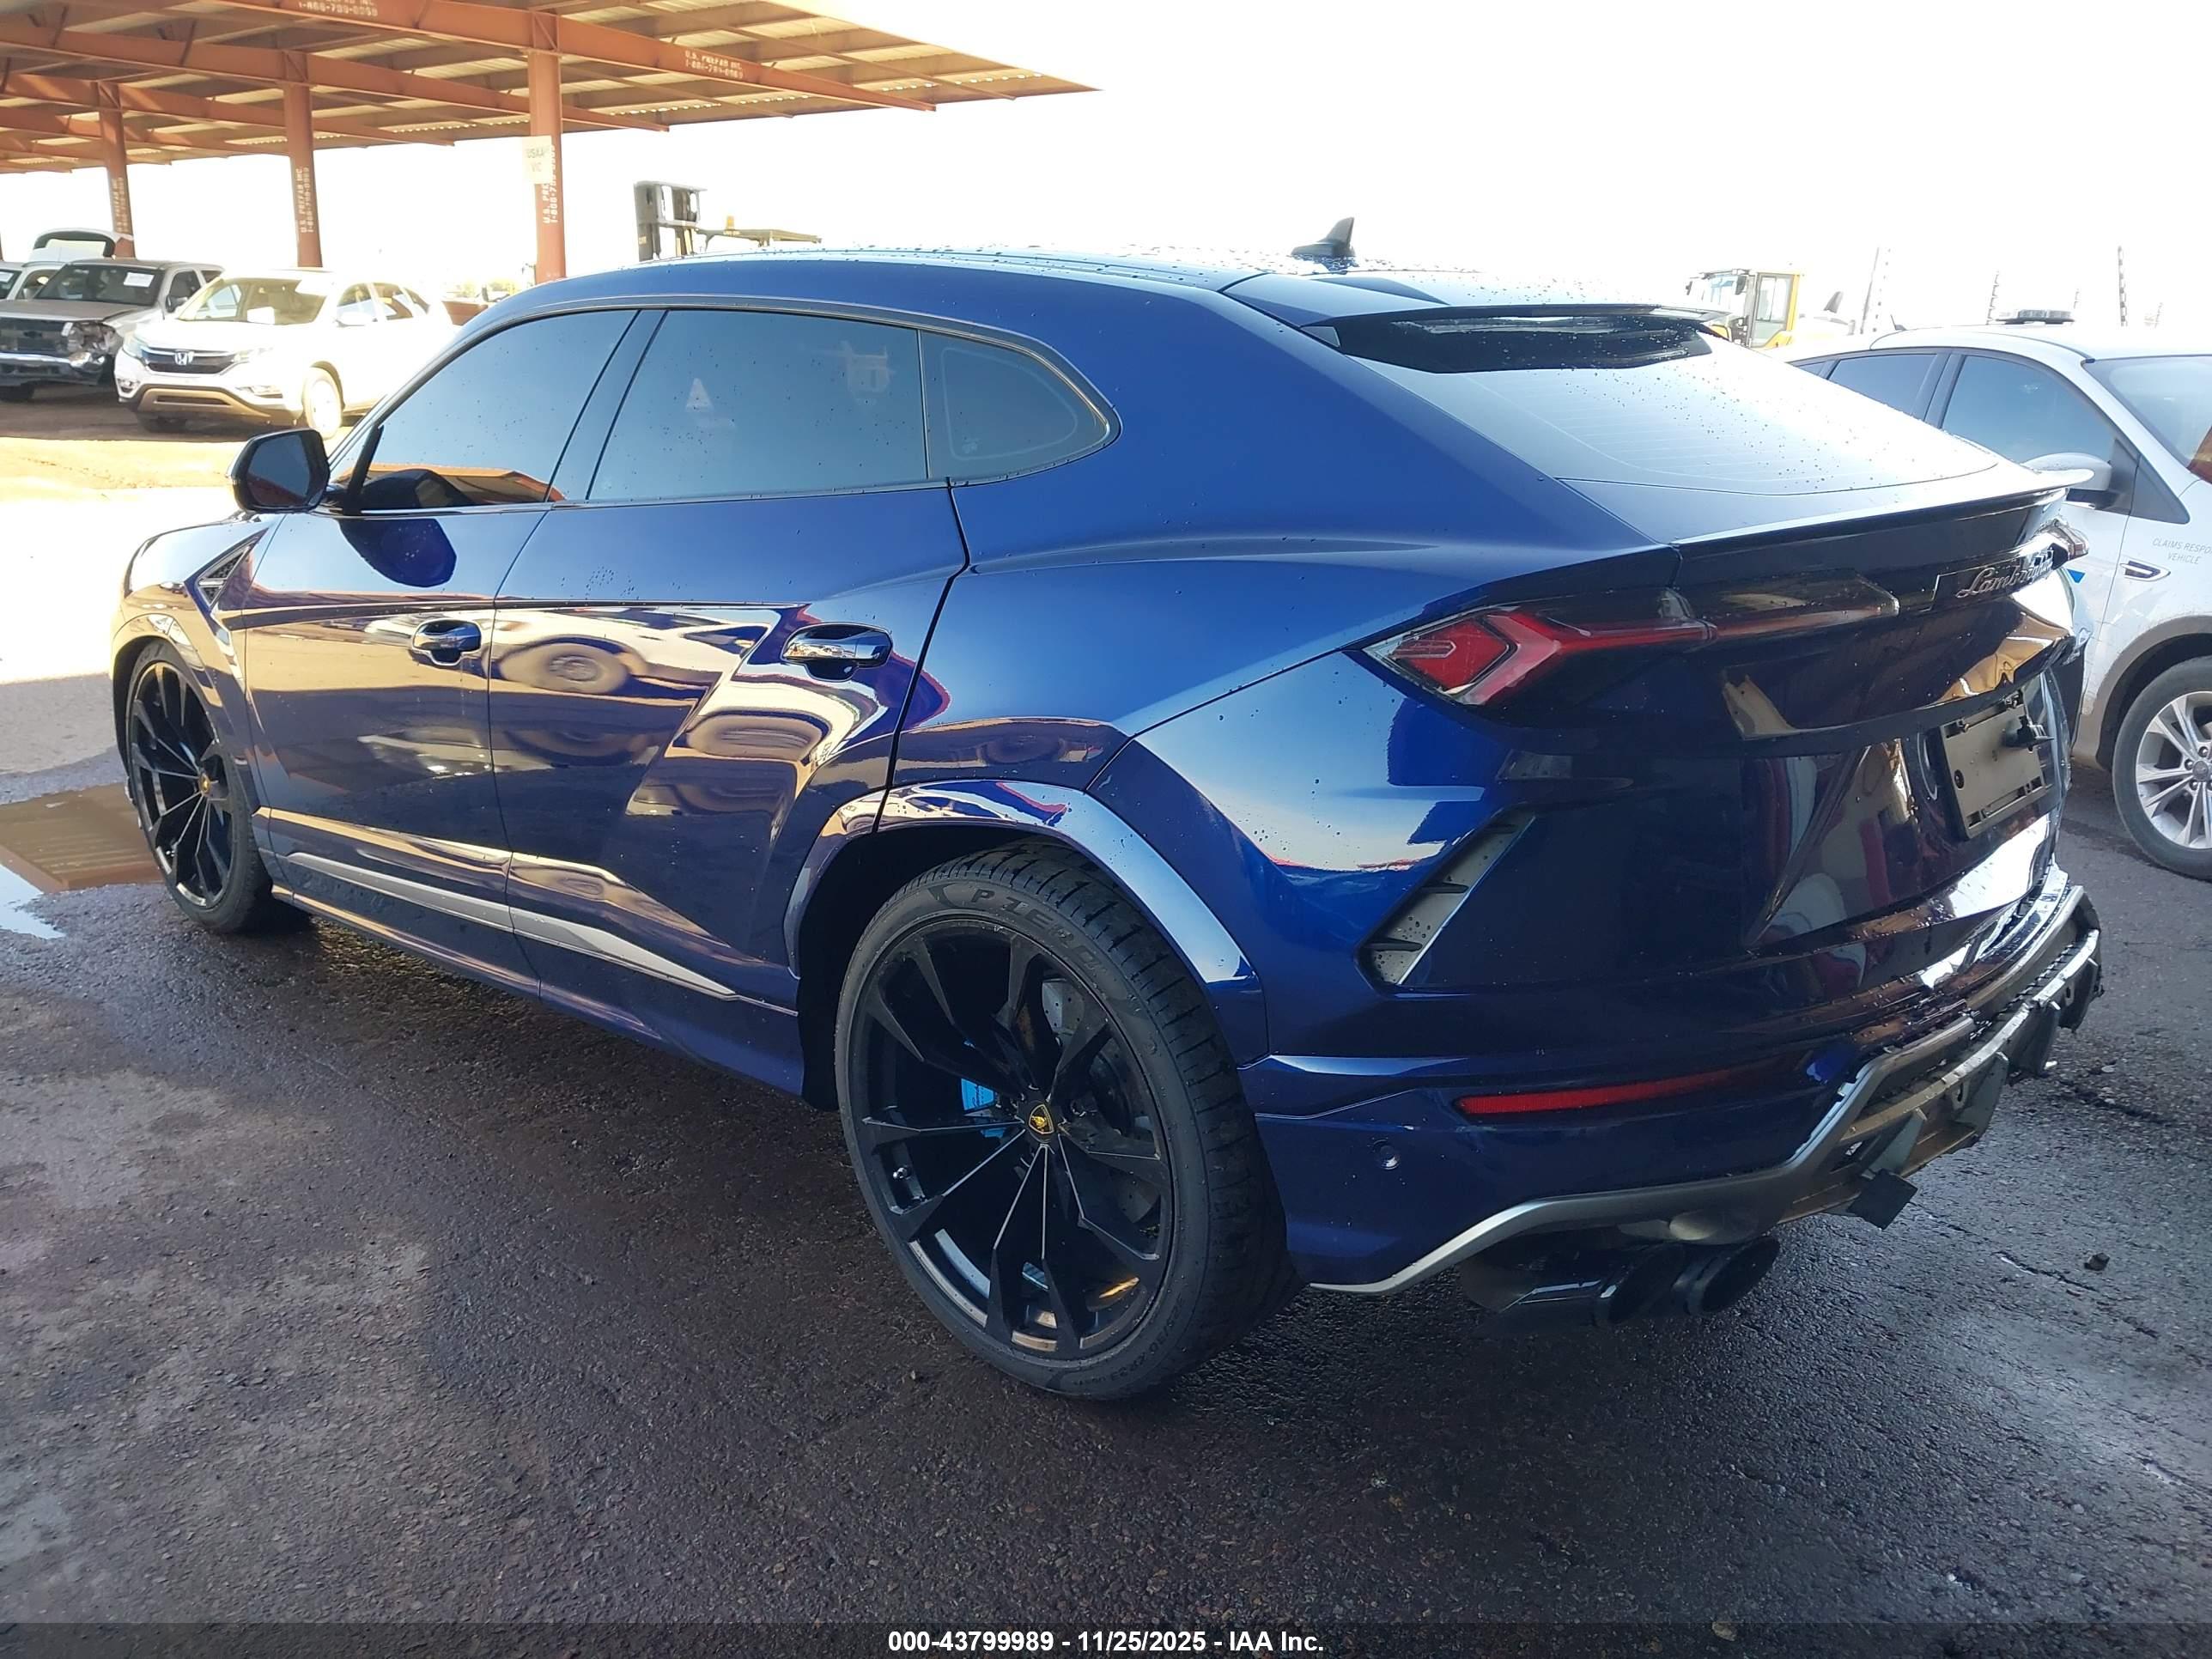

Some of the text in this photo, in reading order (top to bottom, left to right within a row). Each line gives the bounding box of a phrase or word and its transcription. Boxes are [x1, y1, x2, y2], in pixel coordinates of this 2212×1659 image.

[2152, 538, 2212, 556] CLAIMS RESPO
[2167, 551, 2202, 565] VEHICLE
[970, 887, 996, 904] P
